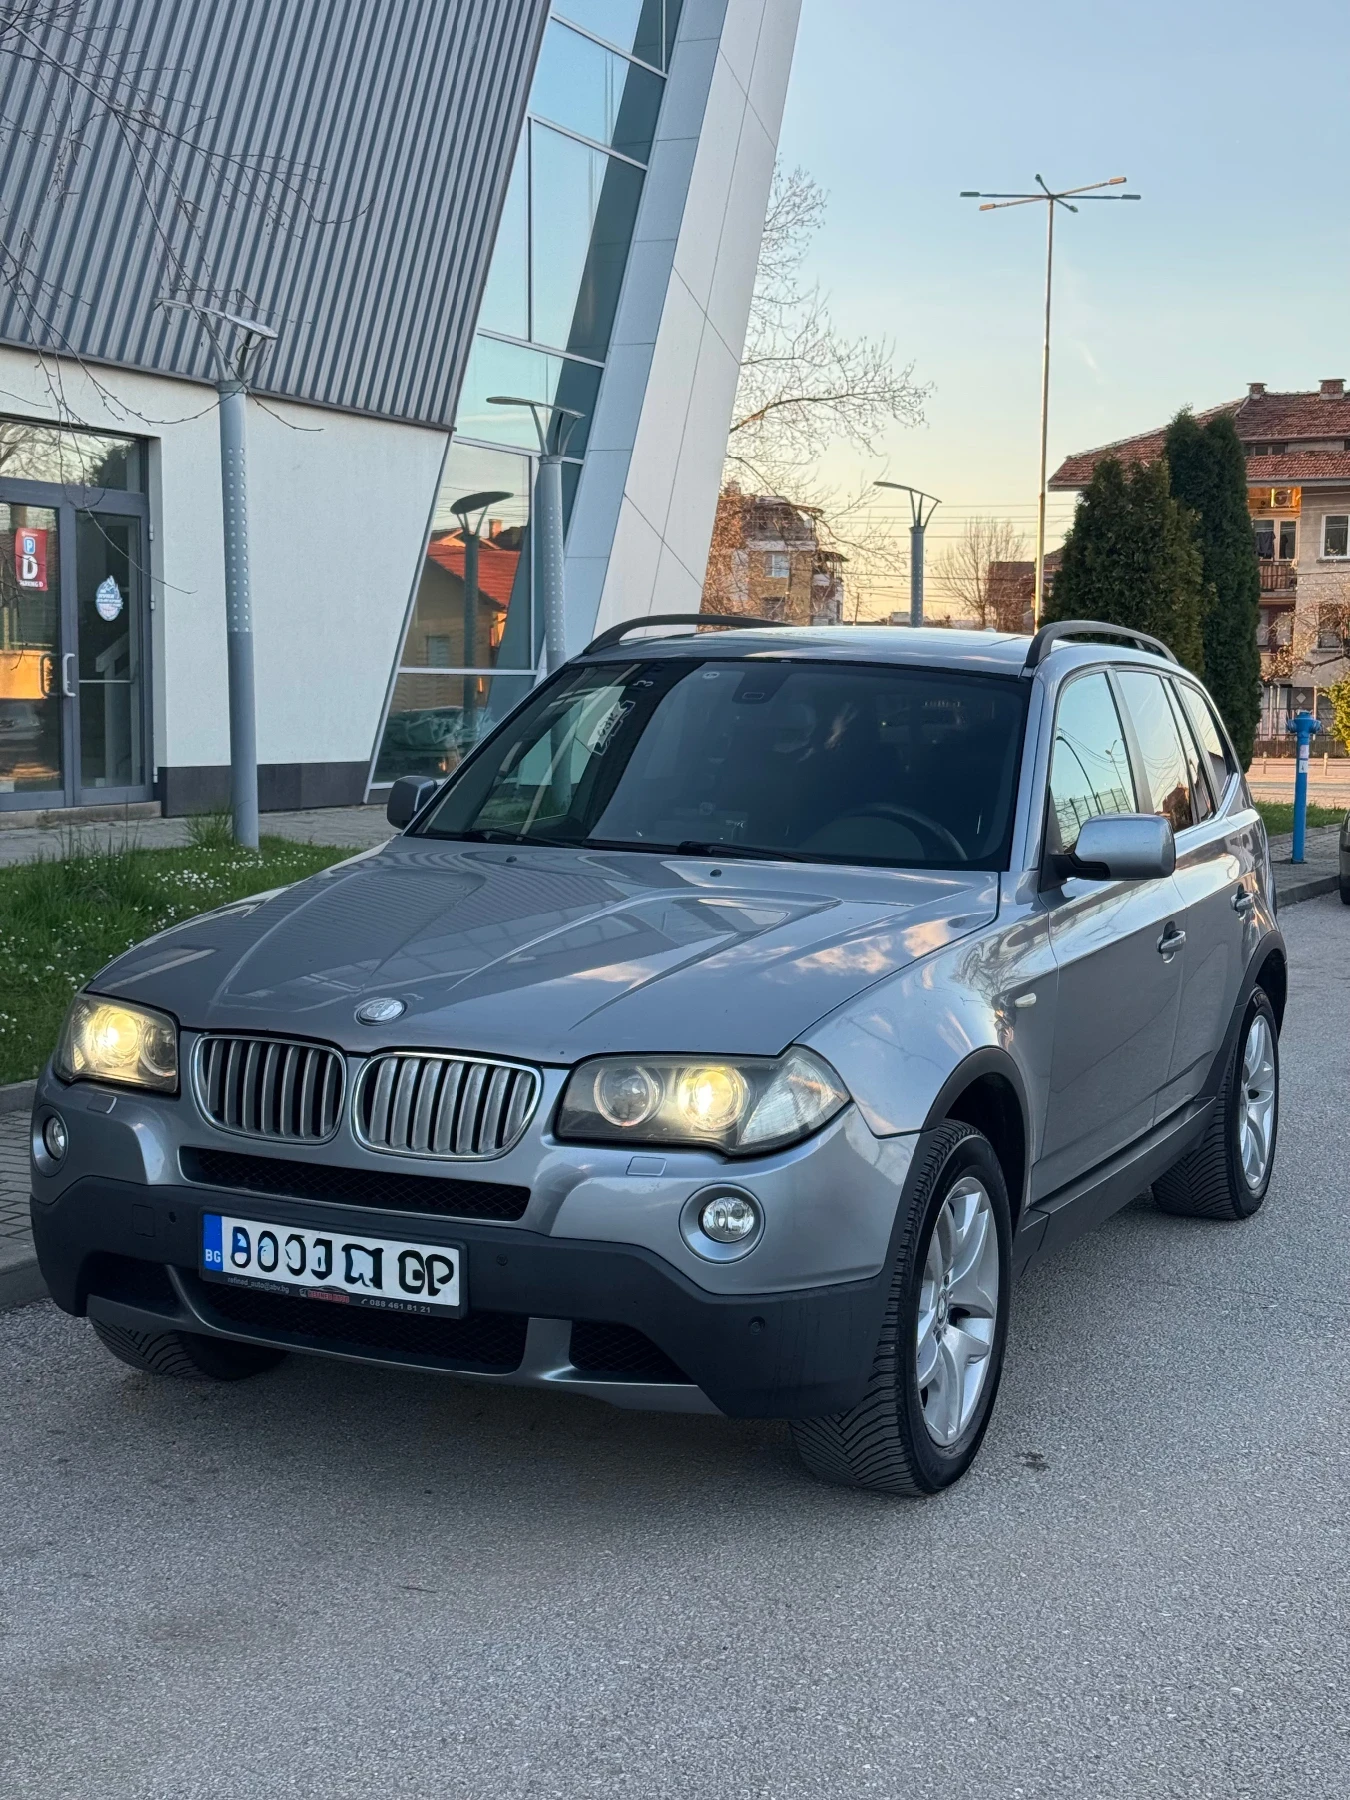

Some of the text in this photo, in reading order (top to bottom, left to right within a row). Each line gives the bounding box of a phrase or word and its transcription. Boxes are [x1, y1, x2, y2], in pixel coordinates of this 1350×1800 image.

[26, 539, 34, 553] P
[22, 554, 39, 580] D
[205, 1248, 222, 1263] BG
[387, 1301, 404, 1310] 461
[407, 1303, 418, 1312] 81
[420, 1305, 431, 1313] 21
